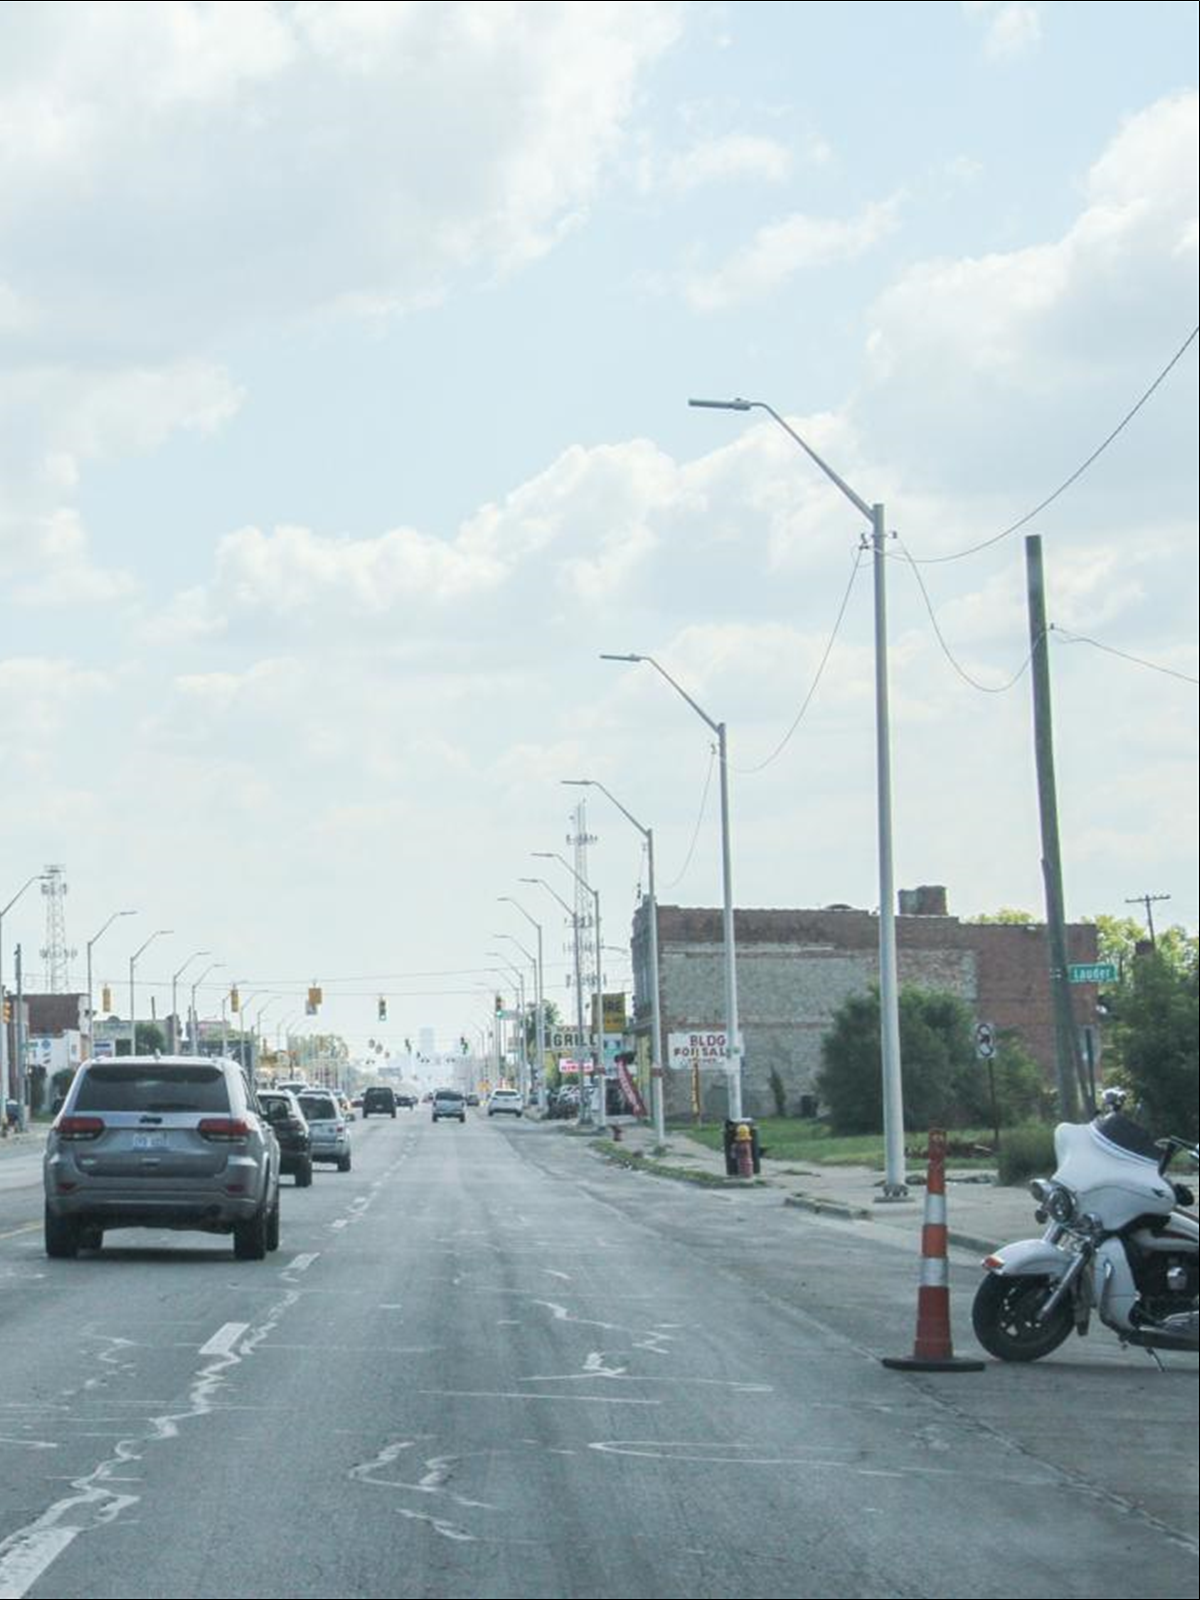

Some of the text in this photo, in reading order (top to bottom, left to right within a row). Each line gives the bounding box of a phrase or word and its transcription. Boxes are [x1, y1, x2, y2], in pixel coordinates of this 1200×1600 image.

[1074, 968, 1110, 979] Lauder
[554, 1033, 599, 1047] GRILL
[690, 1035, 726, 1046] BLDG
[702, 1048, 731, 1057] SAL
